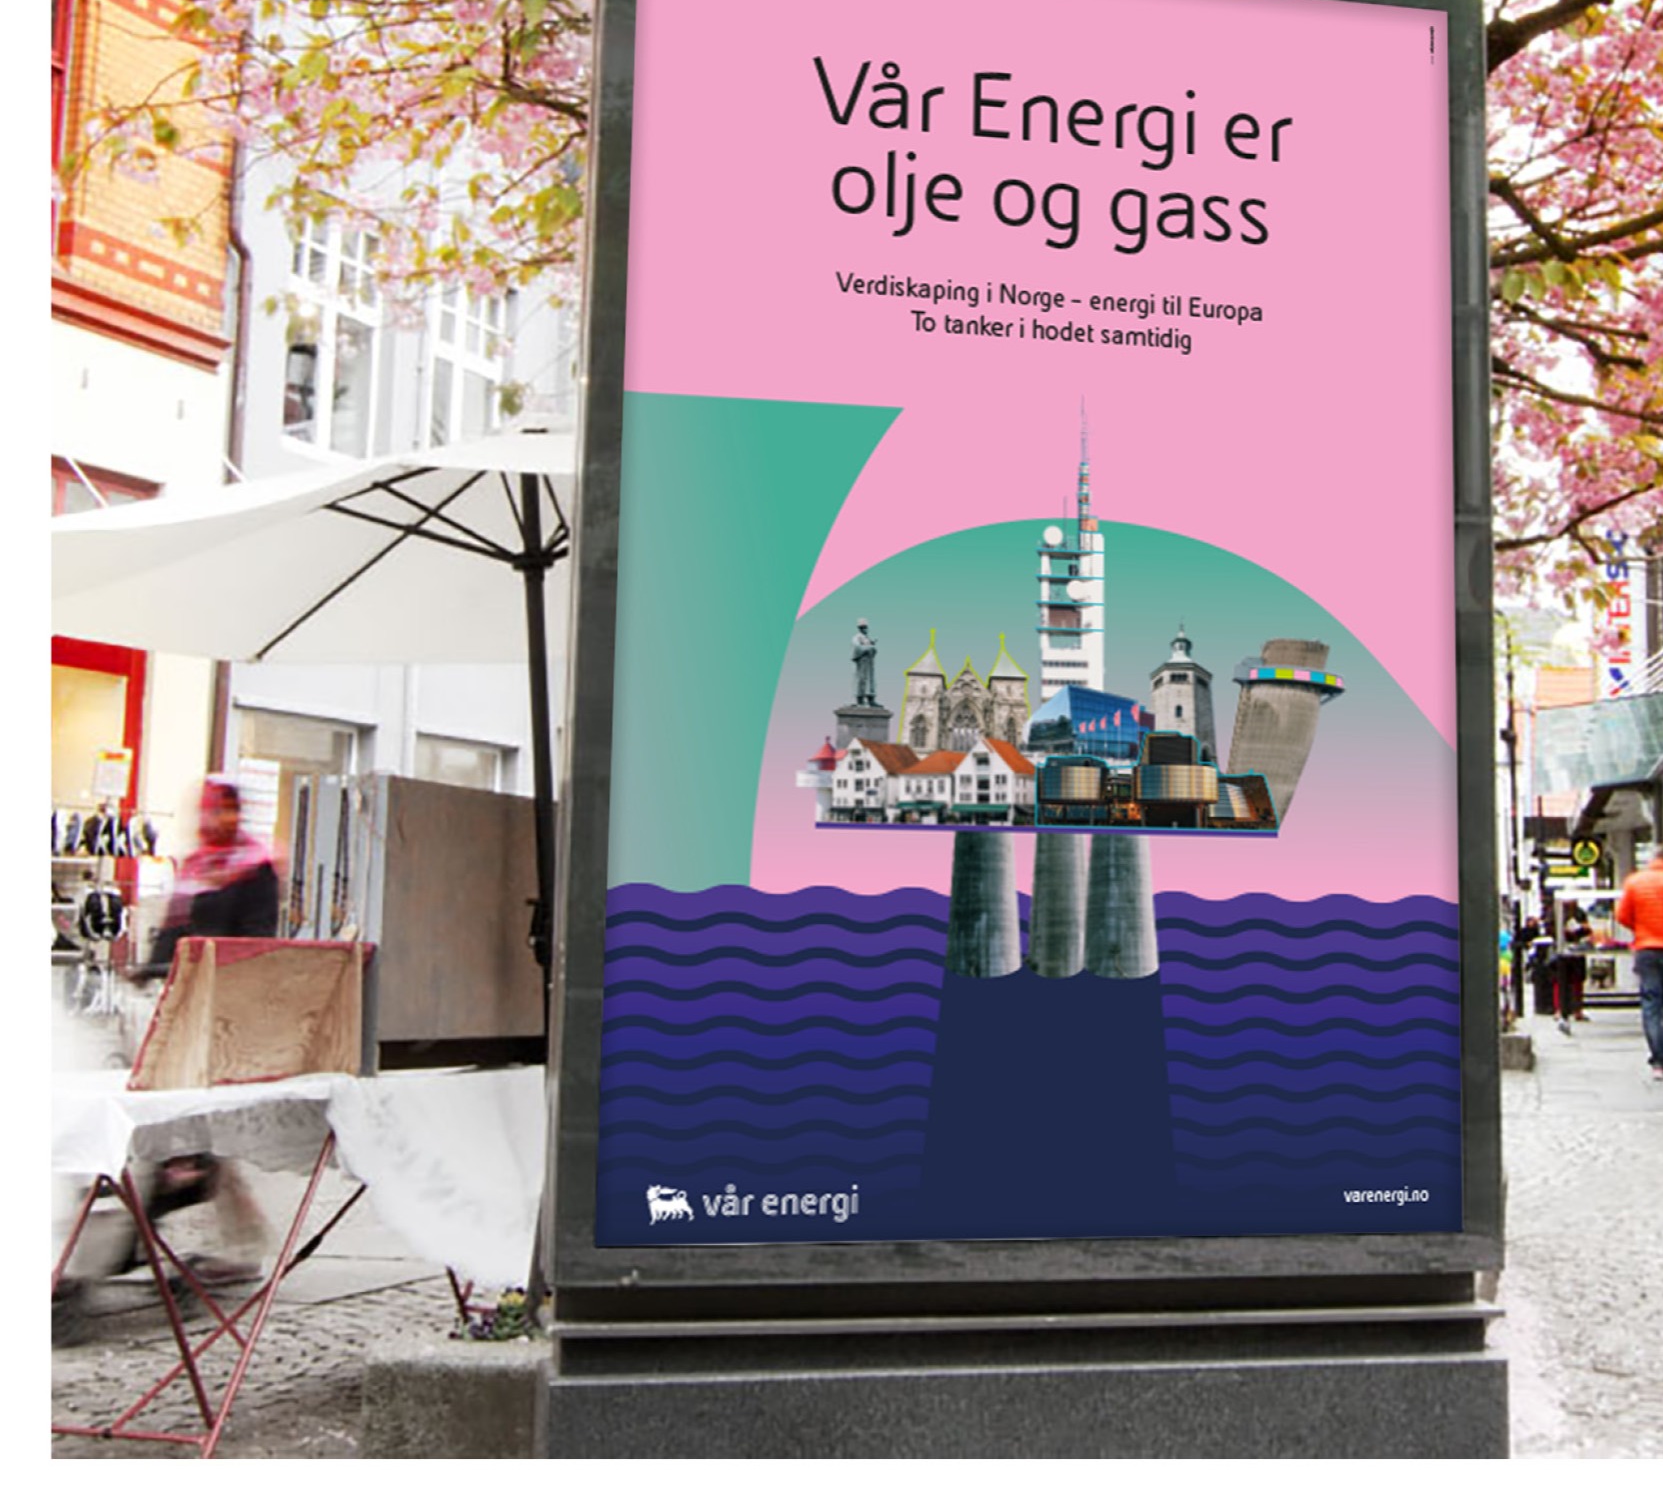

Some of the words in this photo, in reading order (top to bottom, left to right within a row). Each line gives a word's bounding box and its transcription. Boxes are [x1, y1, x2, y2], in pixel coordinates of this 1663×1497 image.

[812, 55, 945, 133] Vår
[972, 71, 1196, 172] Energi
[1224, 112, 1293, 163] er
[831, 151, 964, 238] olje
[993, 178, 1080, 250] og
[1109, 188, 1269, 255] gass
[835, 271, 980, 308] Verdiskaping
[986, 281, 993, 303] i
[999, 282, 1066, 313] Norge
[1089, 293, 1156, 320] energi
[1162, 294, 1182, 317] til
[1188, 296, 1263, 326] Europa
[910, 309, 937, 333] To
[944, 314, 1014, 338] tanker
[1019, 317, 1025, 339] i
[1032, 318, 1095, 344] hodet
[1100, 326, 1192, 356] samtidig
[702, 1183, 755, 1216] vår
[761, 1183, 859, 1223] energi
[1343, 1185, 1430, 1207] varenergi.no
